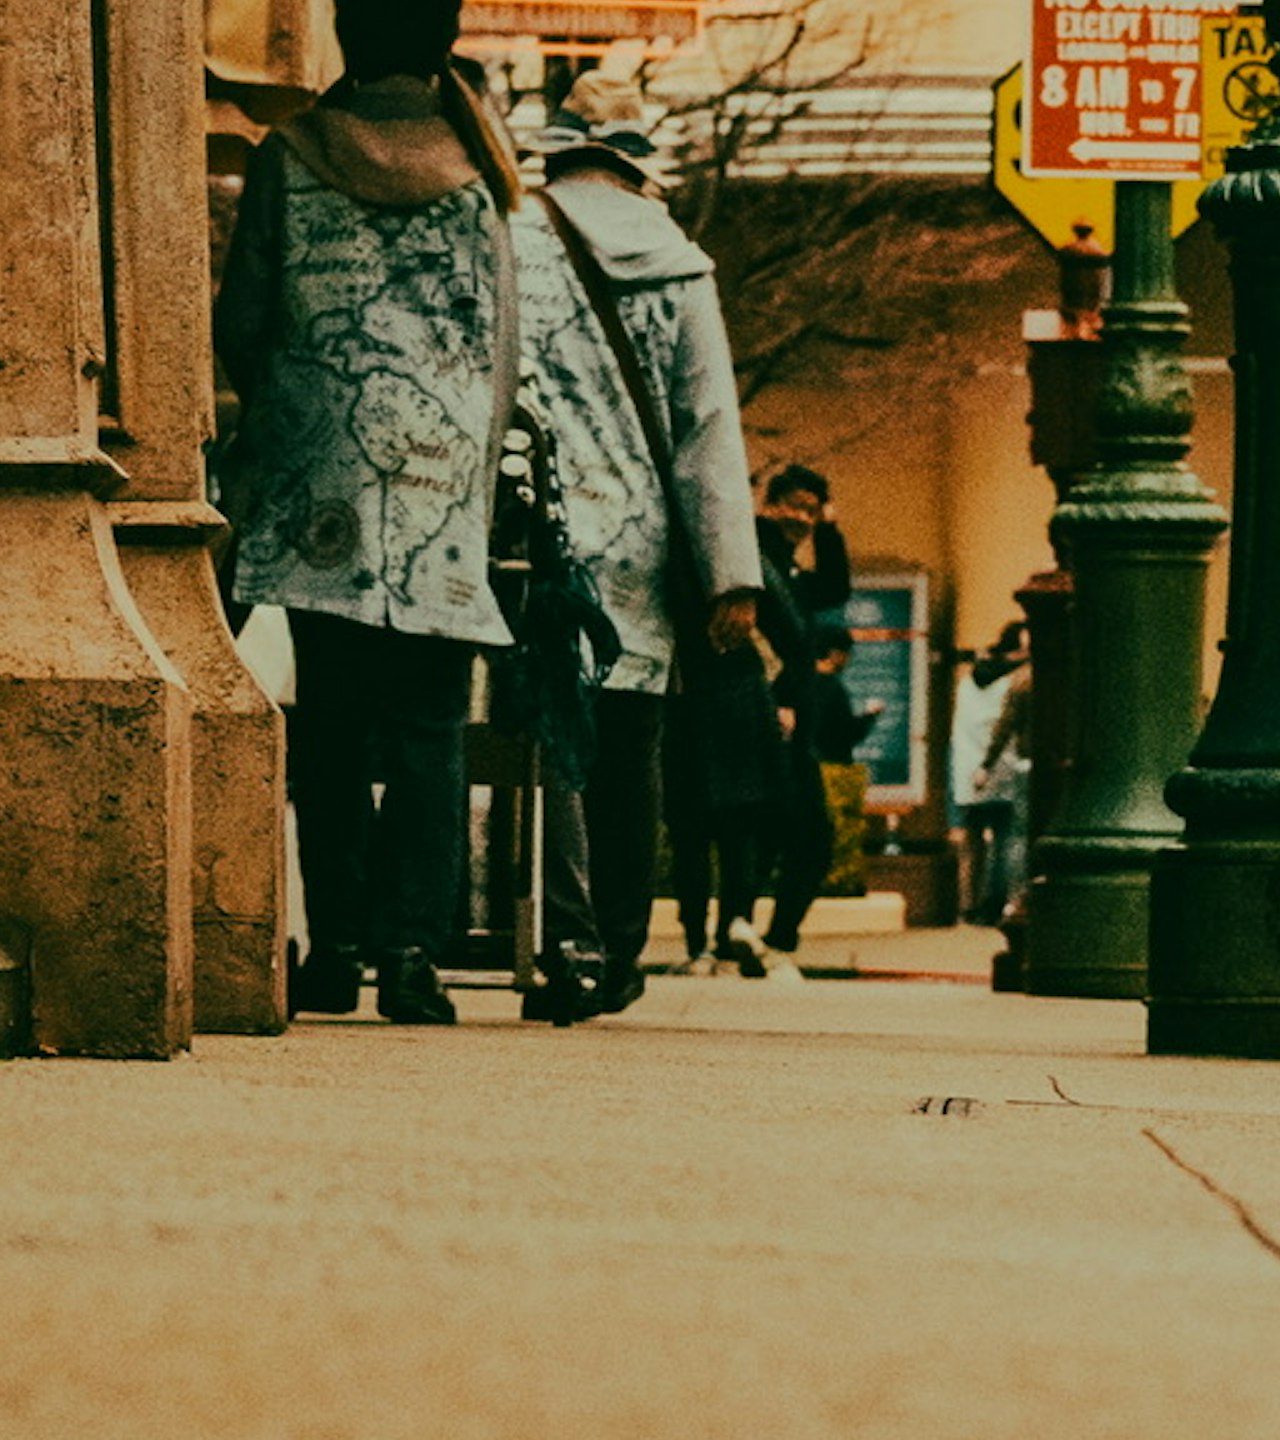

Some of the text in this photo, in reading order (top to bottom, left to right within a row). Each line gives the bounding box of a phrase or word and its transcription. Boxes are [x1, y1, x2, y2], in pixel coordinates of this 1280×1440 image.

[1040, 64, 1068, 108] 8
[1074, 65, 1130, 110] AM
[1171, 67, 1197, 111] 7
